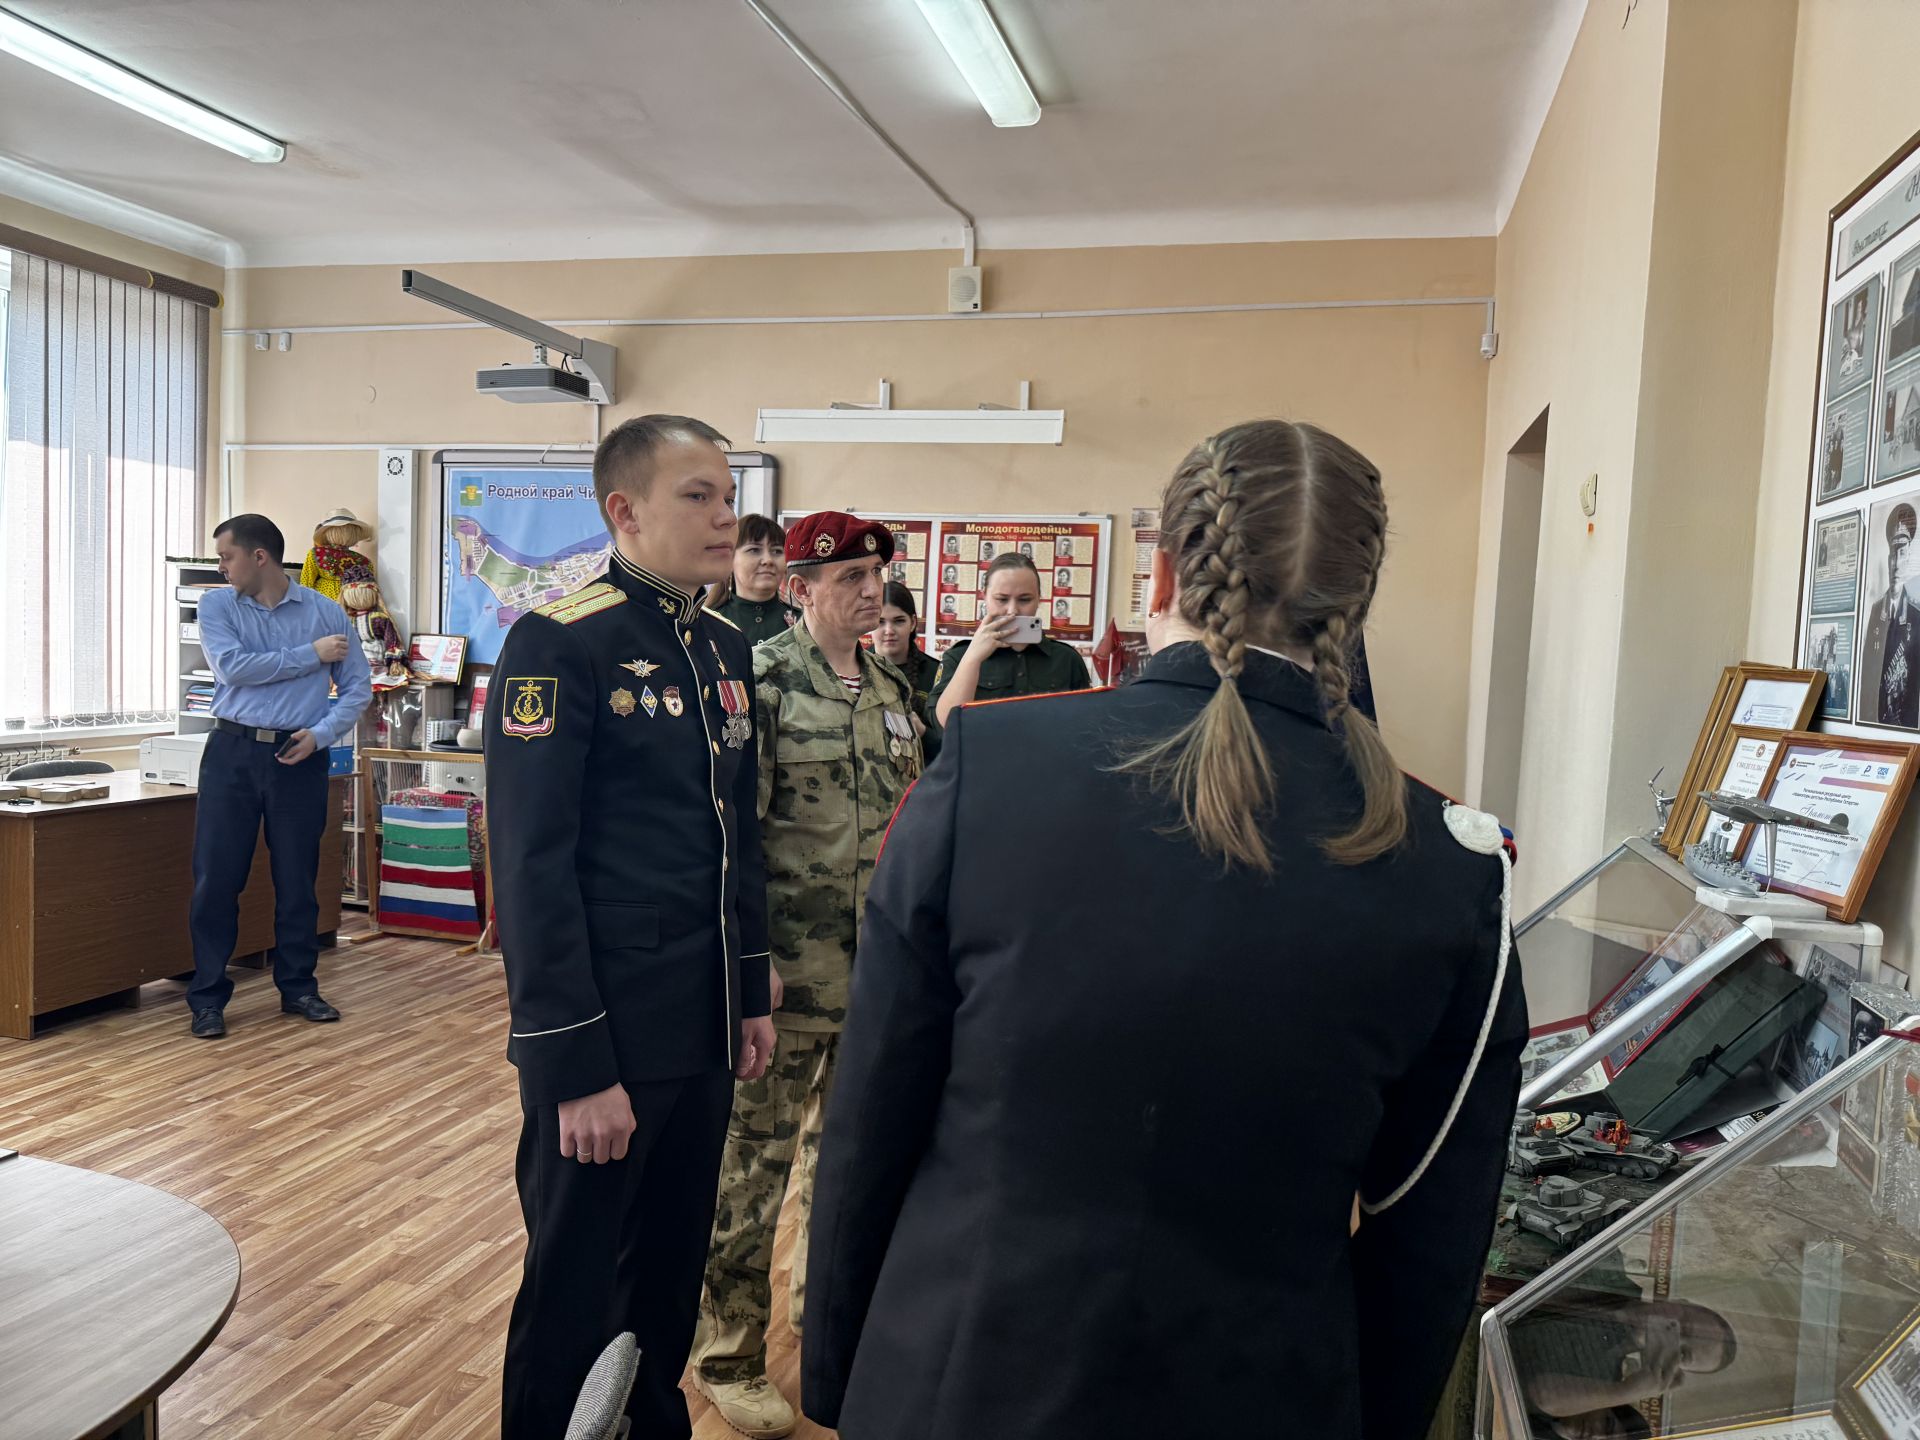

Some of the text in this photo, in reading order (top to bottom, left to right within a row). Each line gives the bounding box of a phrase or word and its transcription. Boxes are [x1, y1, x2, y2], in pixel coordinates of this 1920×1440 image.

[488, 484, 538, 500] Родной
[542, 484, 574, 501] край
[880, 521, 906, 532] еды
[965, 523, 1072, 535] Молодогвардейцы
